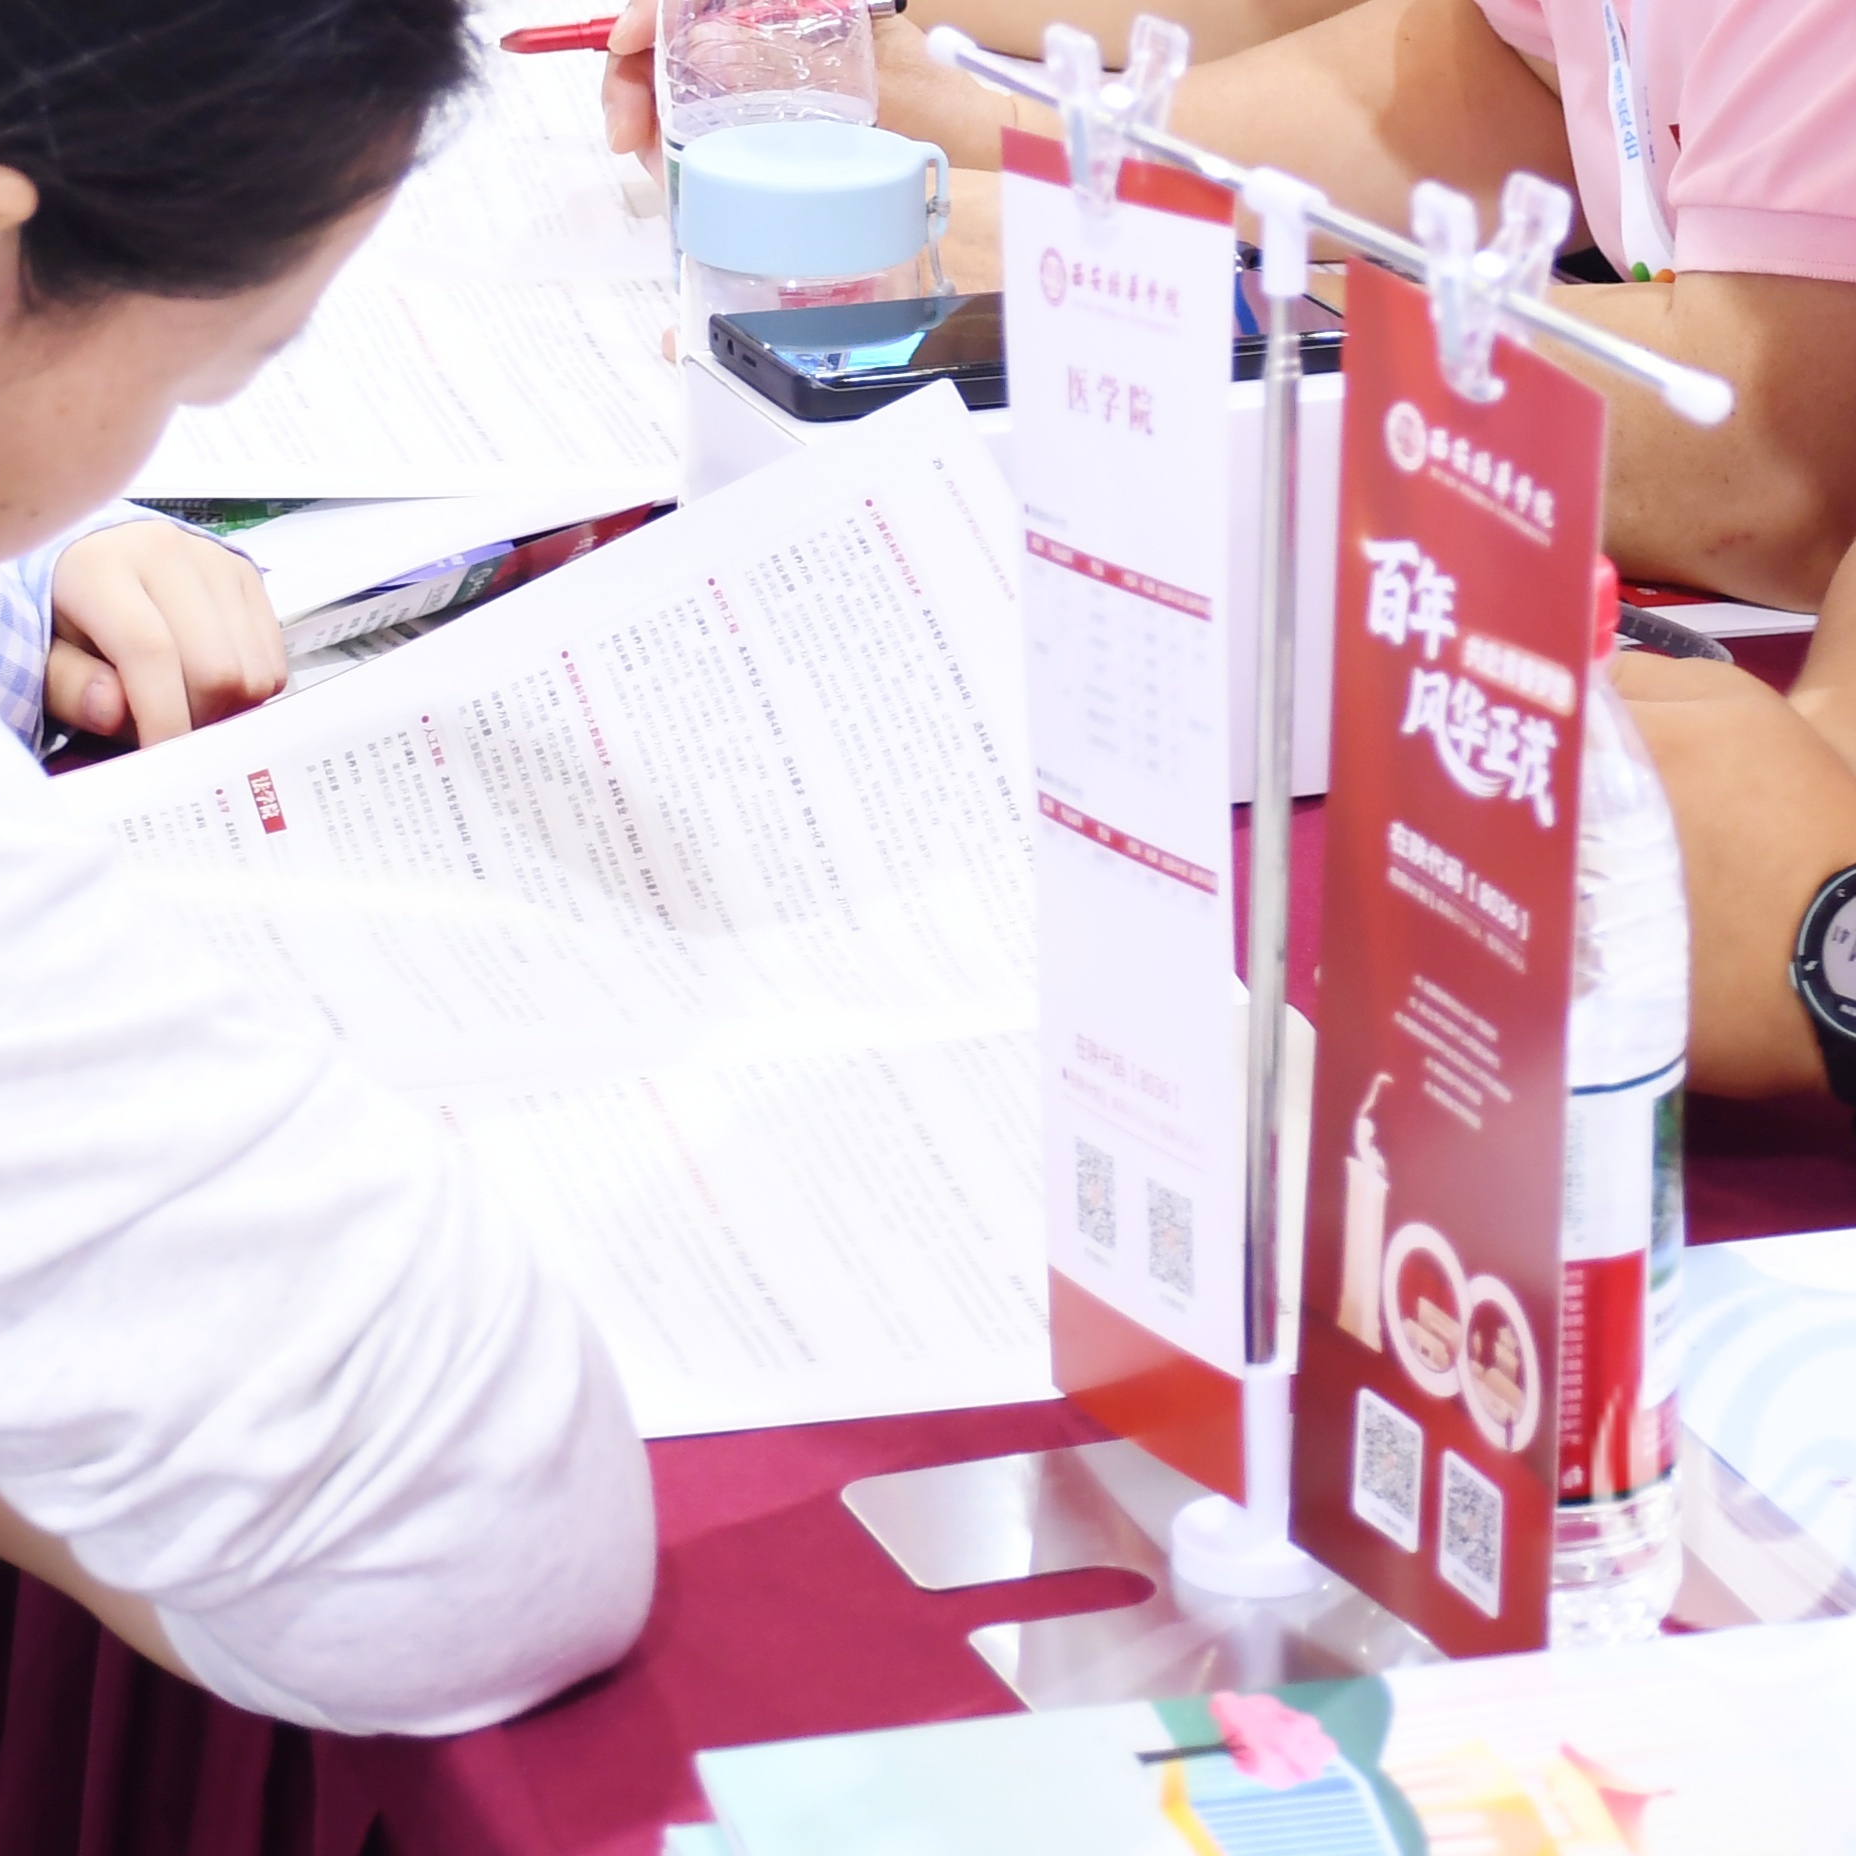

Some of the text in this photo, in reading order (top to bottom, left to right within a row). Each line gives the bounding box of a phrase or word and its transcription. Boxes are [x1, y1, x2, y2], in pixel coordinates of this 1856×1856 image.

[1067, 366, 1155, 436] 医学院
[711, 587, 740, 635] 软件工程
[1360, 537, 1458, 661] 百年
[422, 726, 446, 767] 人工智能
[1402, 668, 1560, 829] 风华正茂
[250, 774, 281, 819] 法学院
